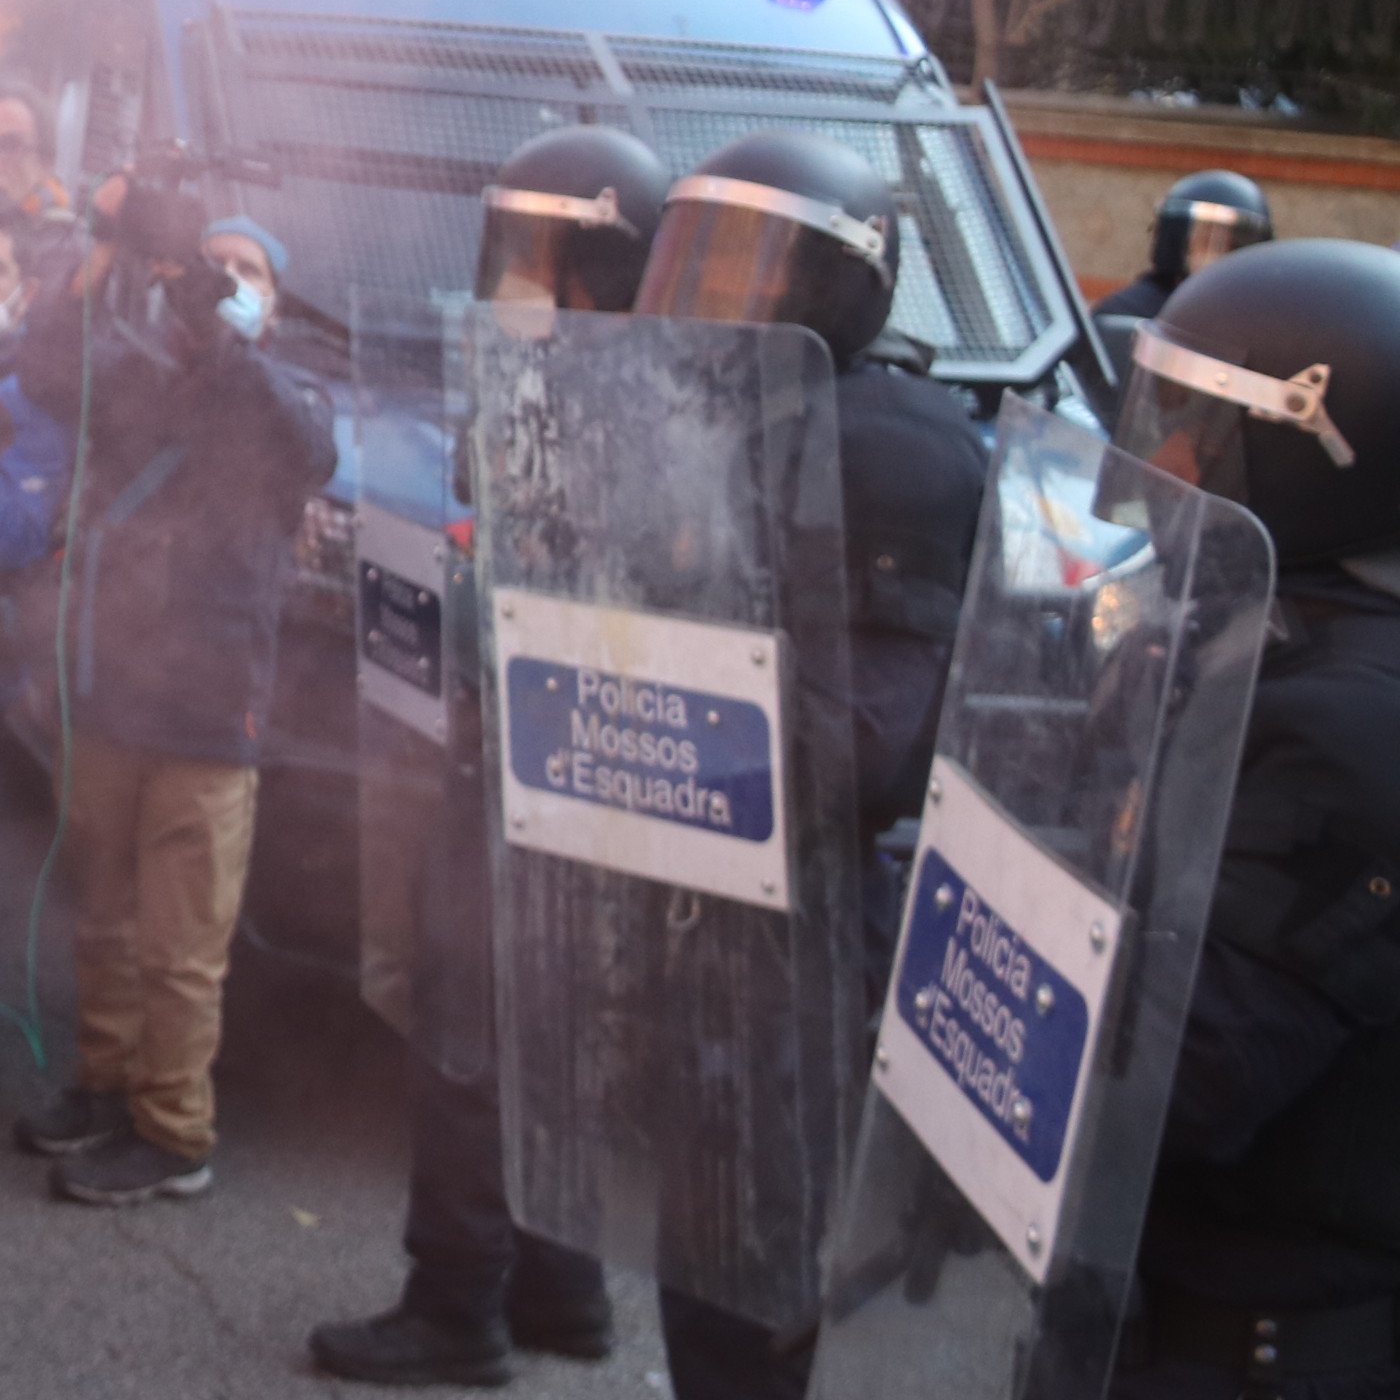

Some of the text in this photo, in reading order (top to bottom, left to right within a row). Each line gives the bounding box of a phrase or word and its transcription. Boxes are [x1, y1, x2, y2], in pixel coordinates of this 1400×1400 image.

[569, 708, 698, 775] Mossos
[576, 668, 688, 729] Policia
[956, 886, 1033, 1001] Policia
[940, 936, 1026, 1063] Mossos
